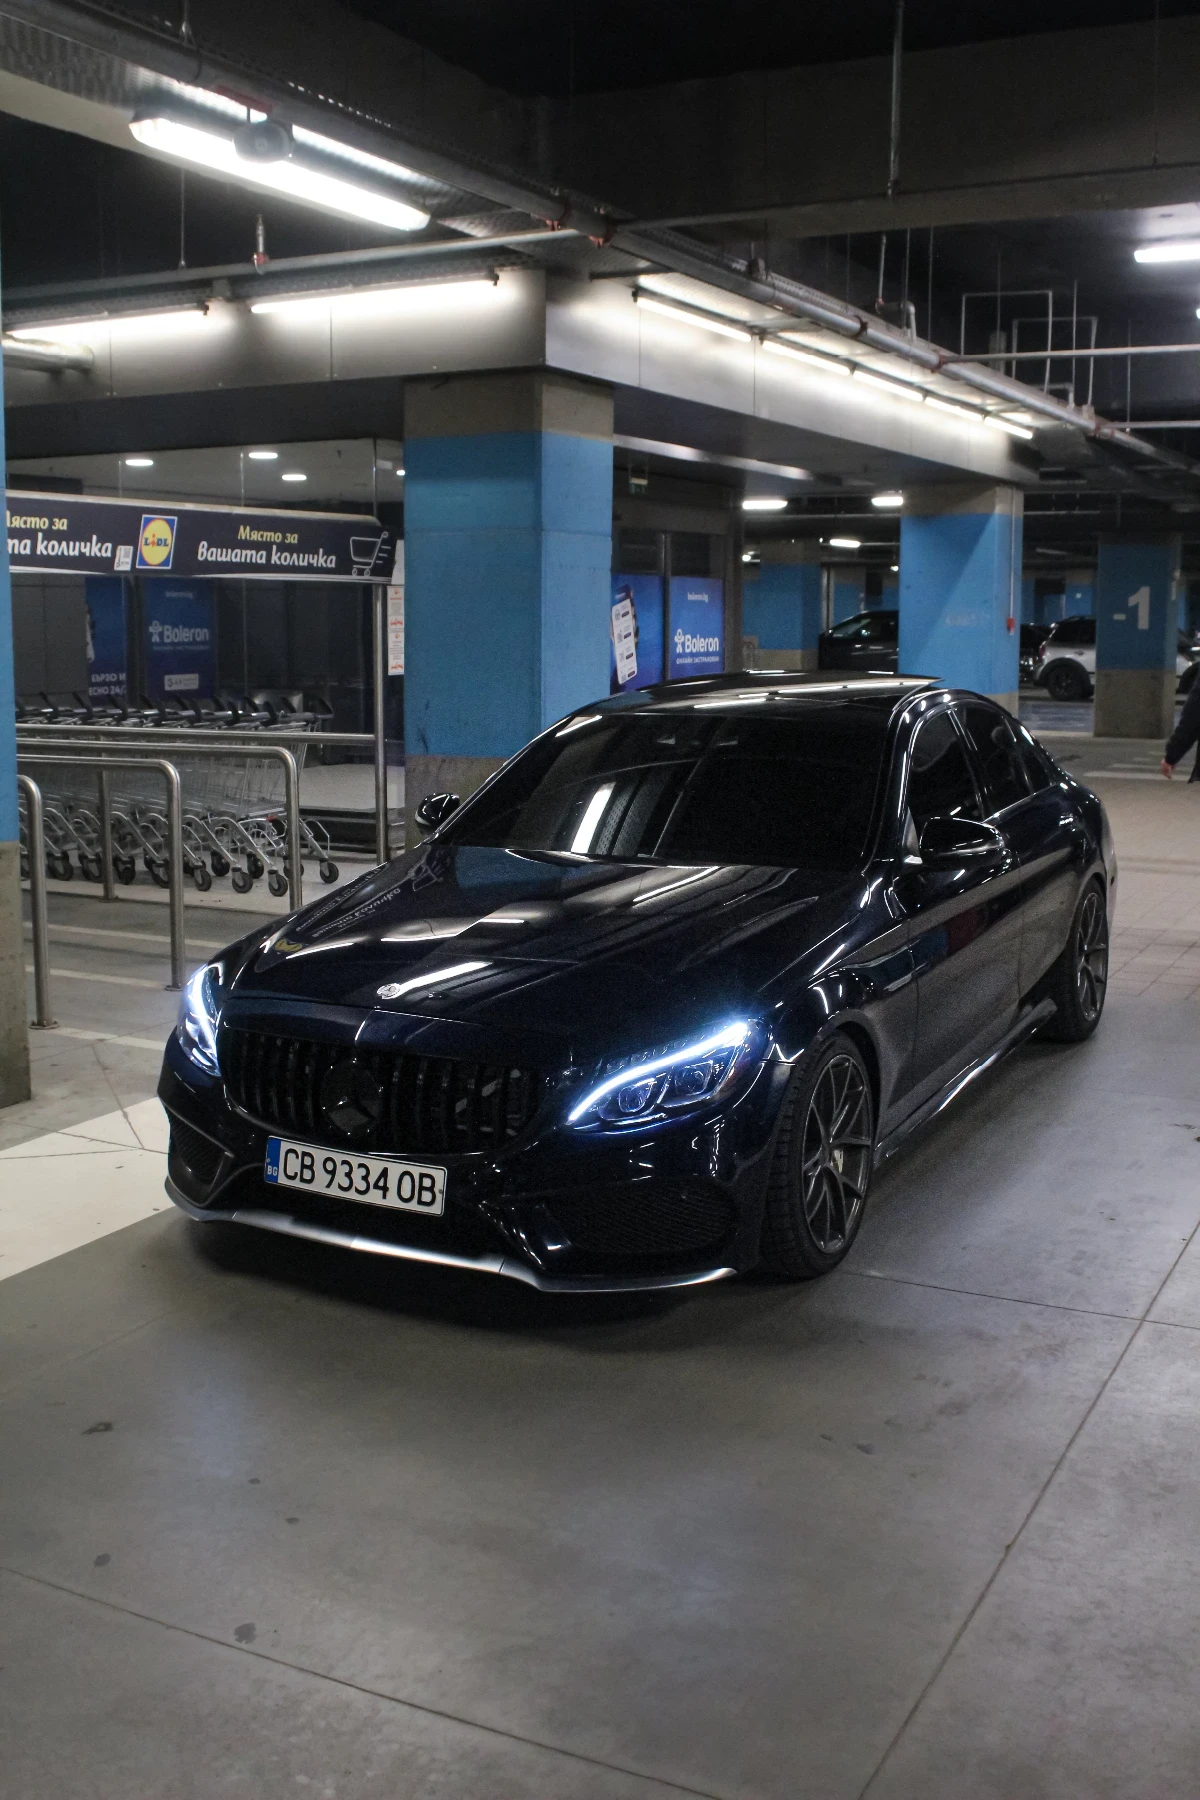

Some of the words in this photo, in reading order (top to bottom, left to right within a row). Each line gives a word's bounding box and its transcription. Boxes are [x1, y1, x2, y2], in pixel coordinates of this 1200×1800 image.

[52, 518, 68, 531] за
[238, 525, 282, 542] Място
[285, 533, 298, 543] за
[36, 532, 112, 557] количка
[197, 541, 266, 564] вашата
[271, 545, 336, 568] количка
[163, 625, 209, 642] Boleron
[685, 634, 719, 653] Boleron
[267, 1165, 278, 1177] BG
[283, 1148, 315, 1184] CB
[322, 1156, 389, 1200] 9334
